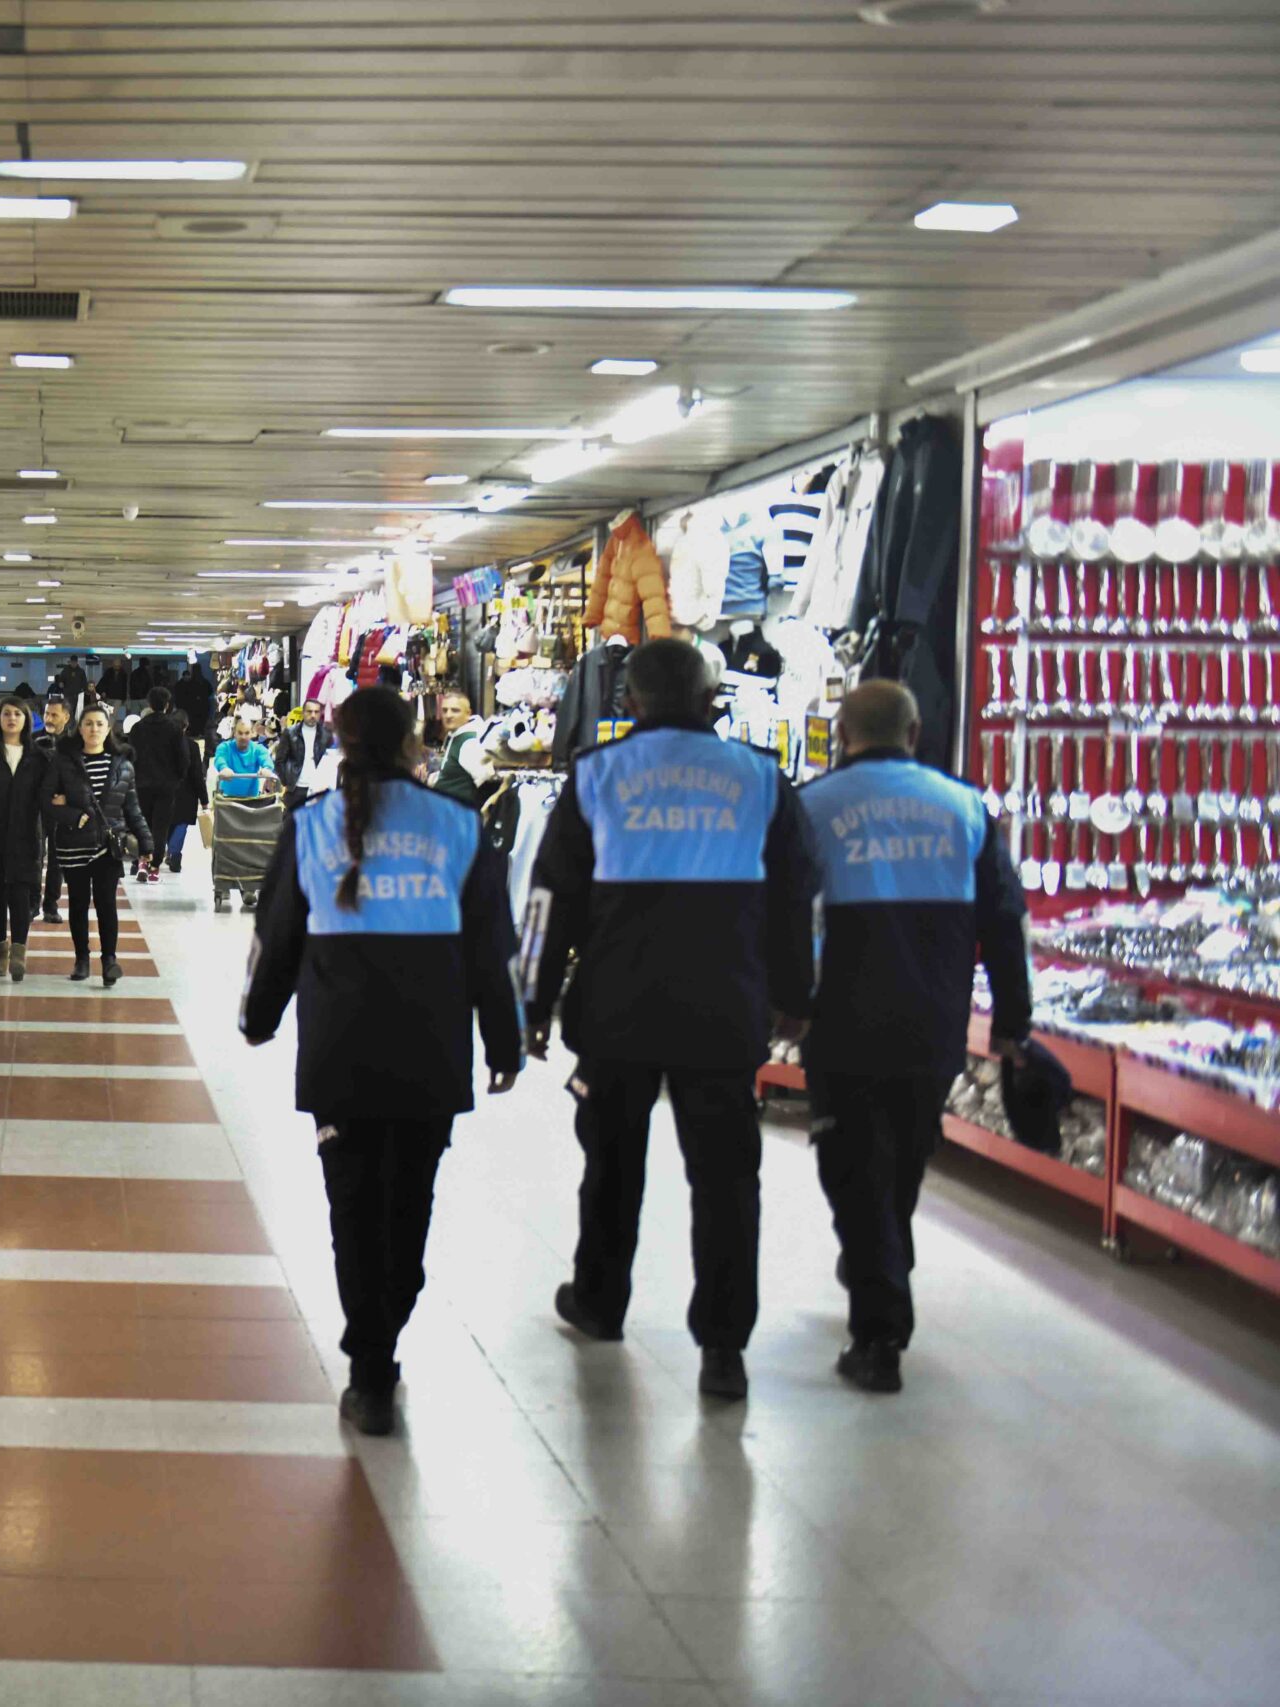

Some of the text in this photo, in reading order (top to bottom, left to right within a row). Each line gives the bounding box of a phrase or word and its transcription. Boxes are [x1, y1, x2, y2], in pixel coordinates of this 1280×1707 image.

[624, 805, 737, 831] ZABITA
[324, 828, 448, 873] BÜÜKŞEHİR
[845, 834, 956, 863] ZABITA
[333, 872, 448, 899] ABITA
